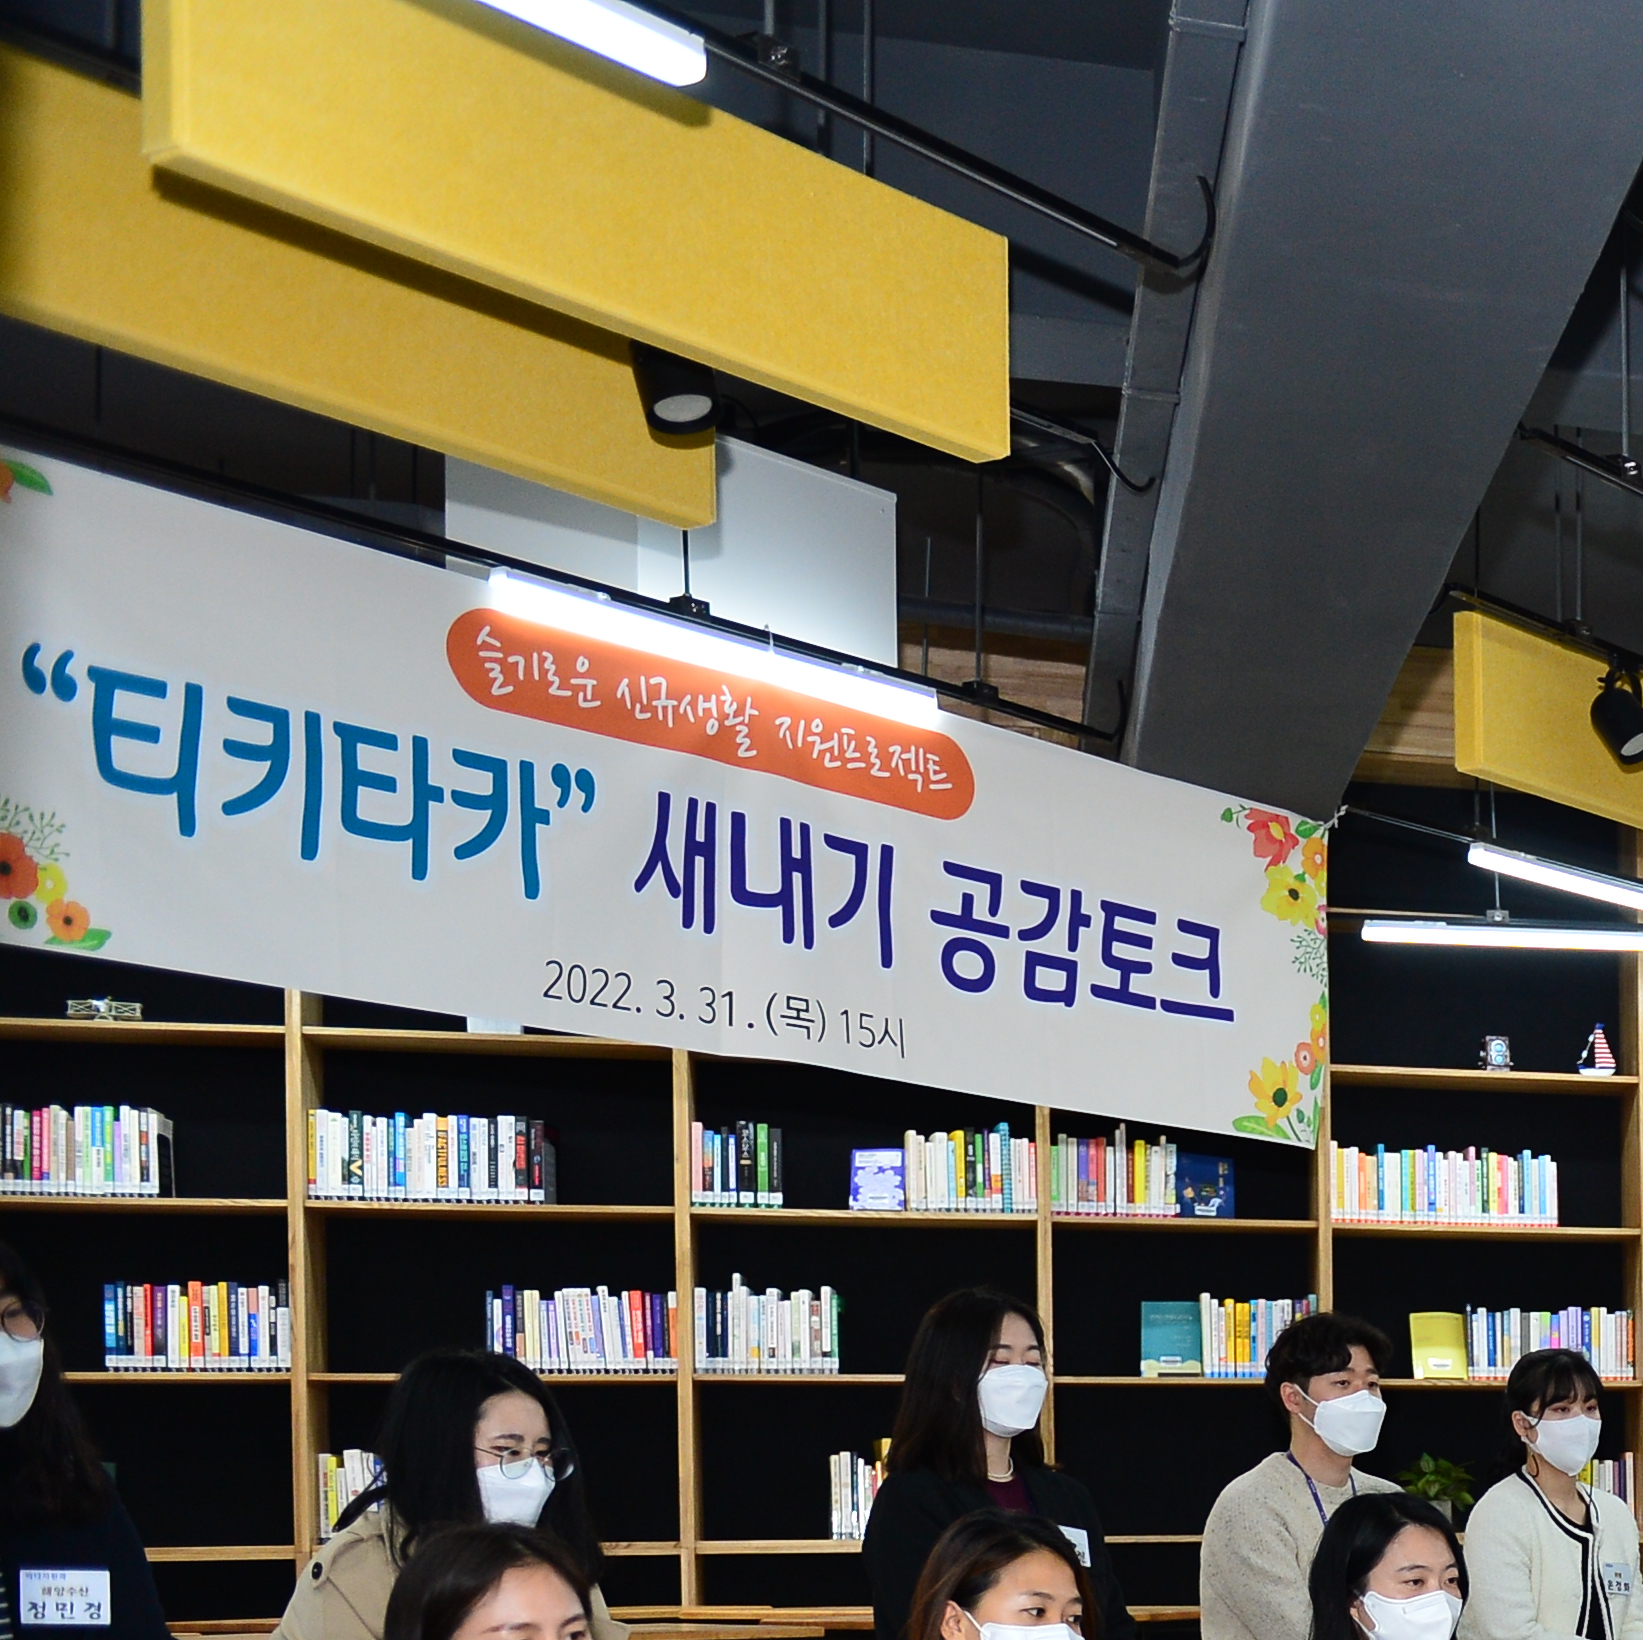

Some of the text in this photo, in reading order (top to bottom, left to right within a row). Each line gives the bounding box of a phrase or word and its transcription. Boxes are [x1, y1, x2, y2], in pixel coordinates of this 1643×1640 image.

[476, 624, 952, 792] 슬기로운 신규생활 지원프로젝트
[634, 790, 894, 969] 새내기
[929, 860, 1235, 1023] 공감토크
[543, 958, 906, 1059] 2022. 3. 31. (목) 15시
[27, 1601, 102, 1620] 정민경
[41, 1586, 89, 1597] 해양수산
